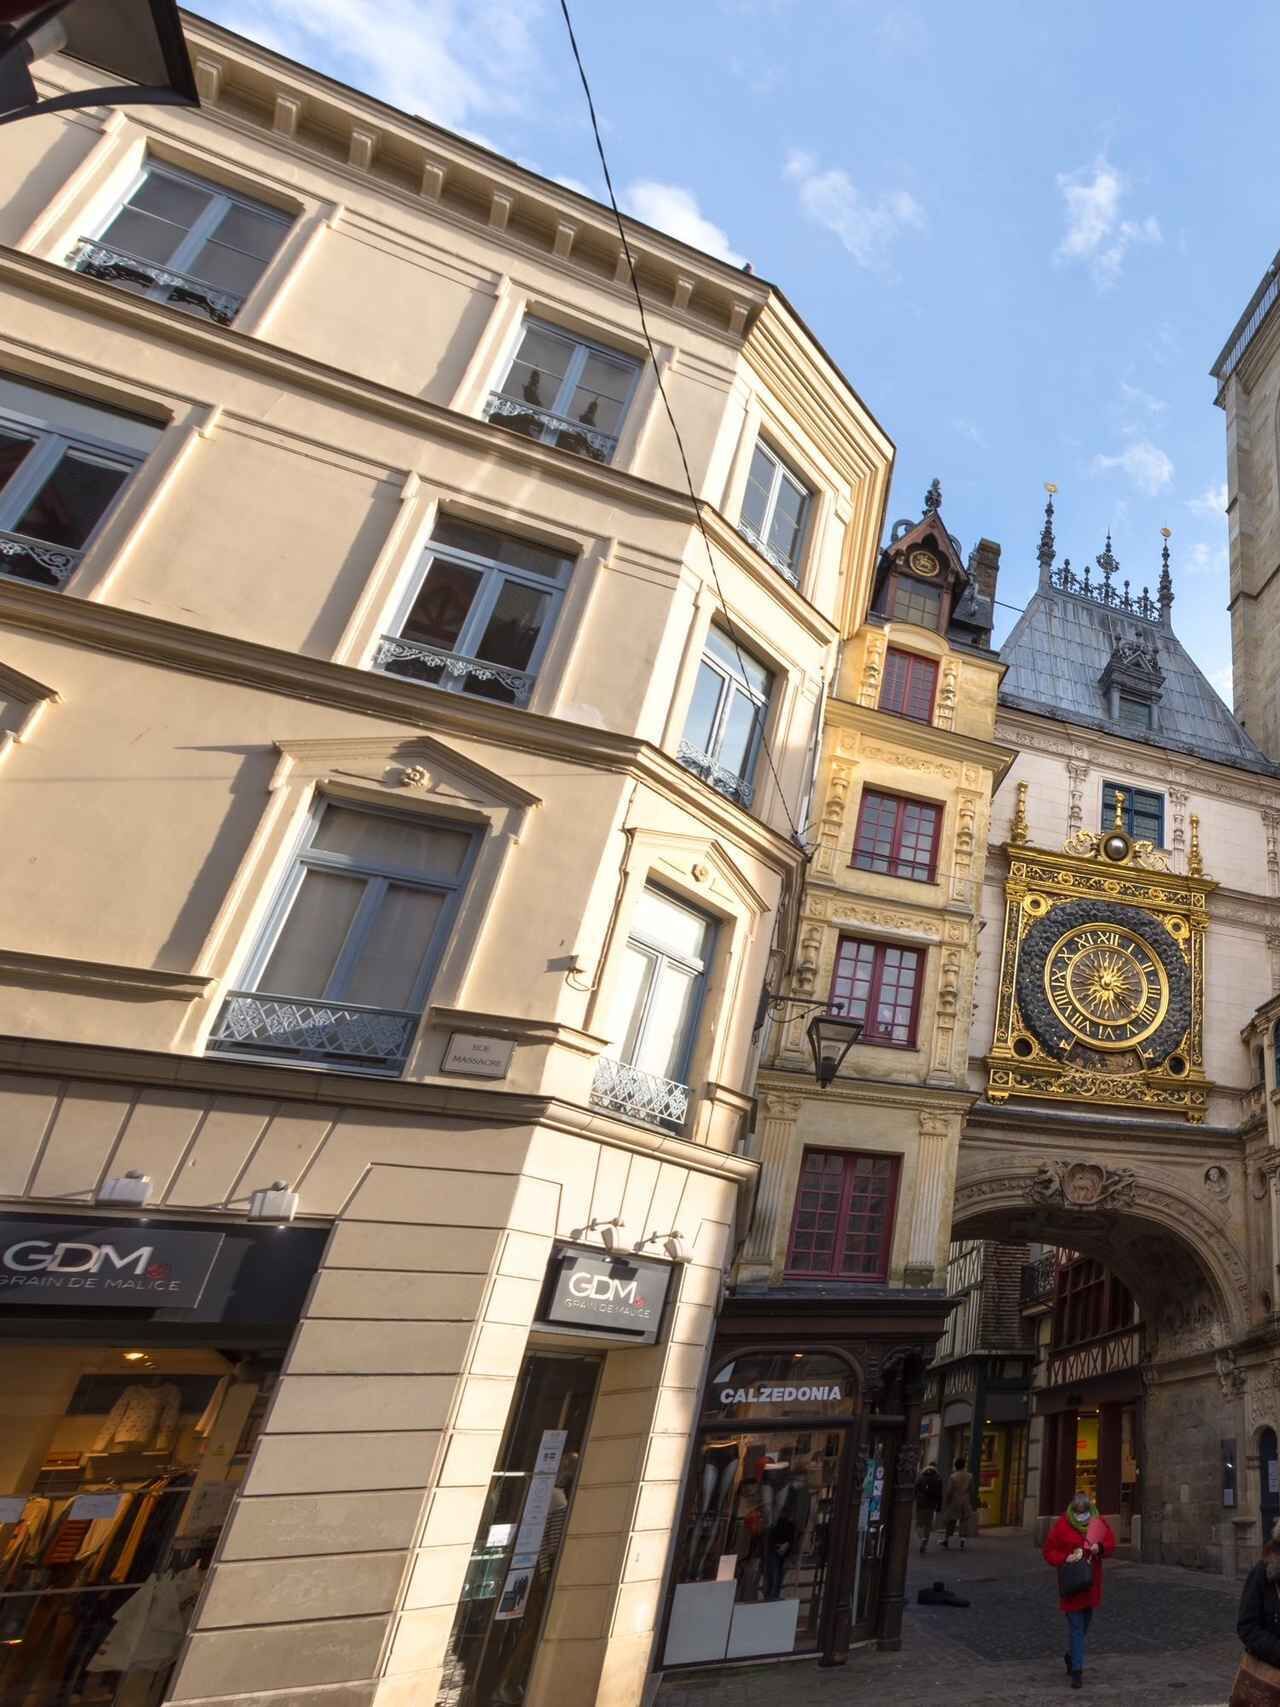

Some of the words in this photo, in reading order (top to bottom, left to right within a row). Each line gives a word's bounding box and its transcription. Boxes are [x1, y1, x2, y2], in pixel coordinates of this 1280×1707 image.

[2, 1240, 155, 1276] GDM
[67, 1276, 100, 1289] DE
[103, 1278, 183, 1292] MALICE
[568, 1271, 638, 1305] GDM
[720, 1385, 841, 1403] CALZEDONIA
